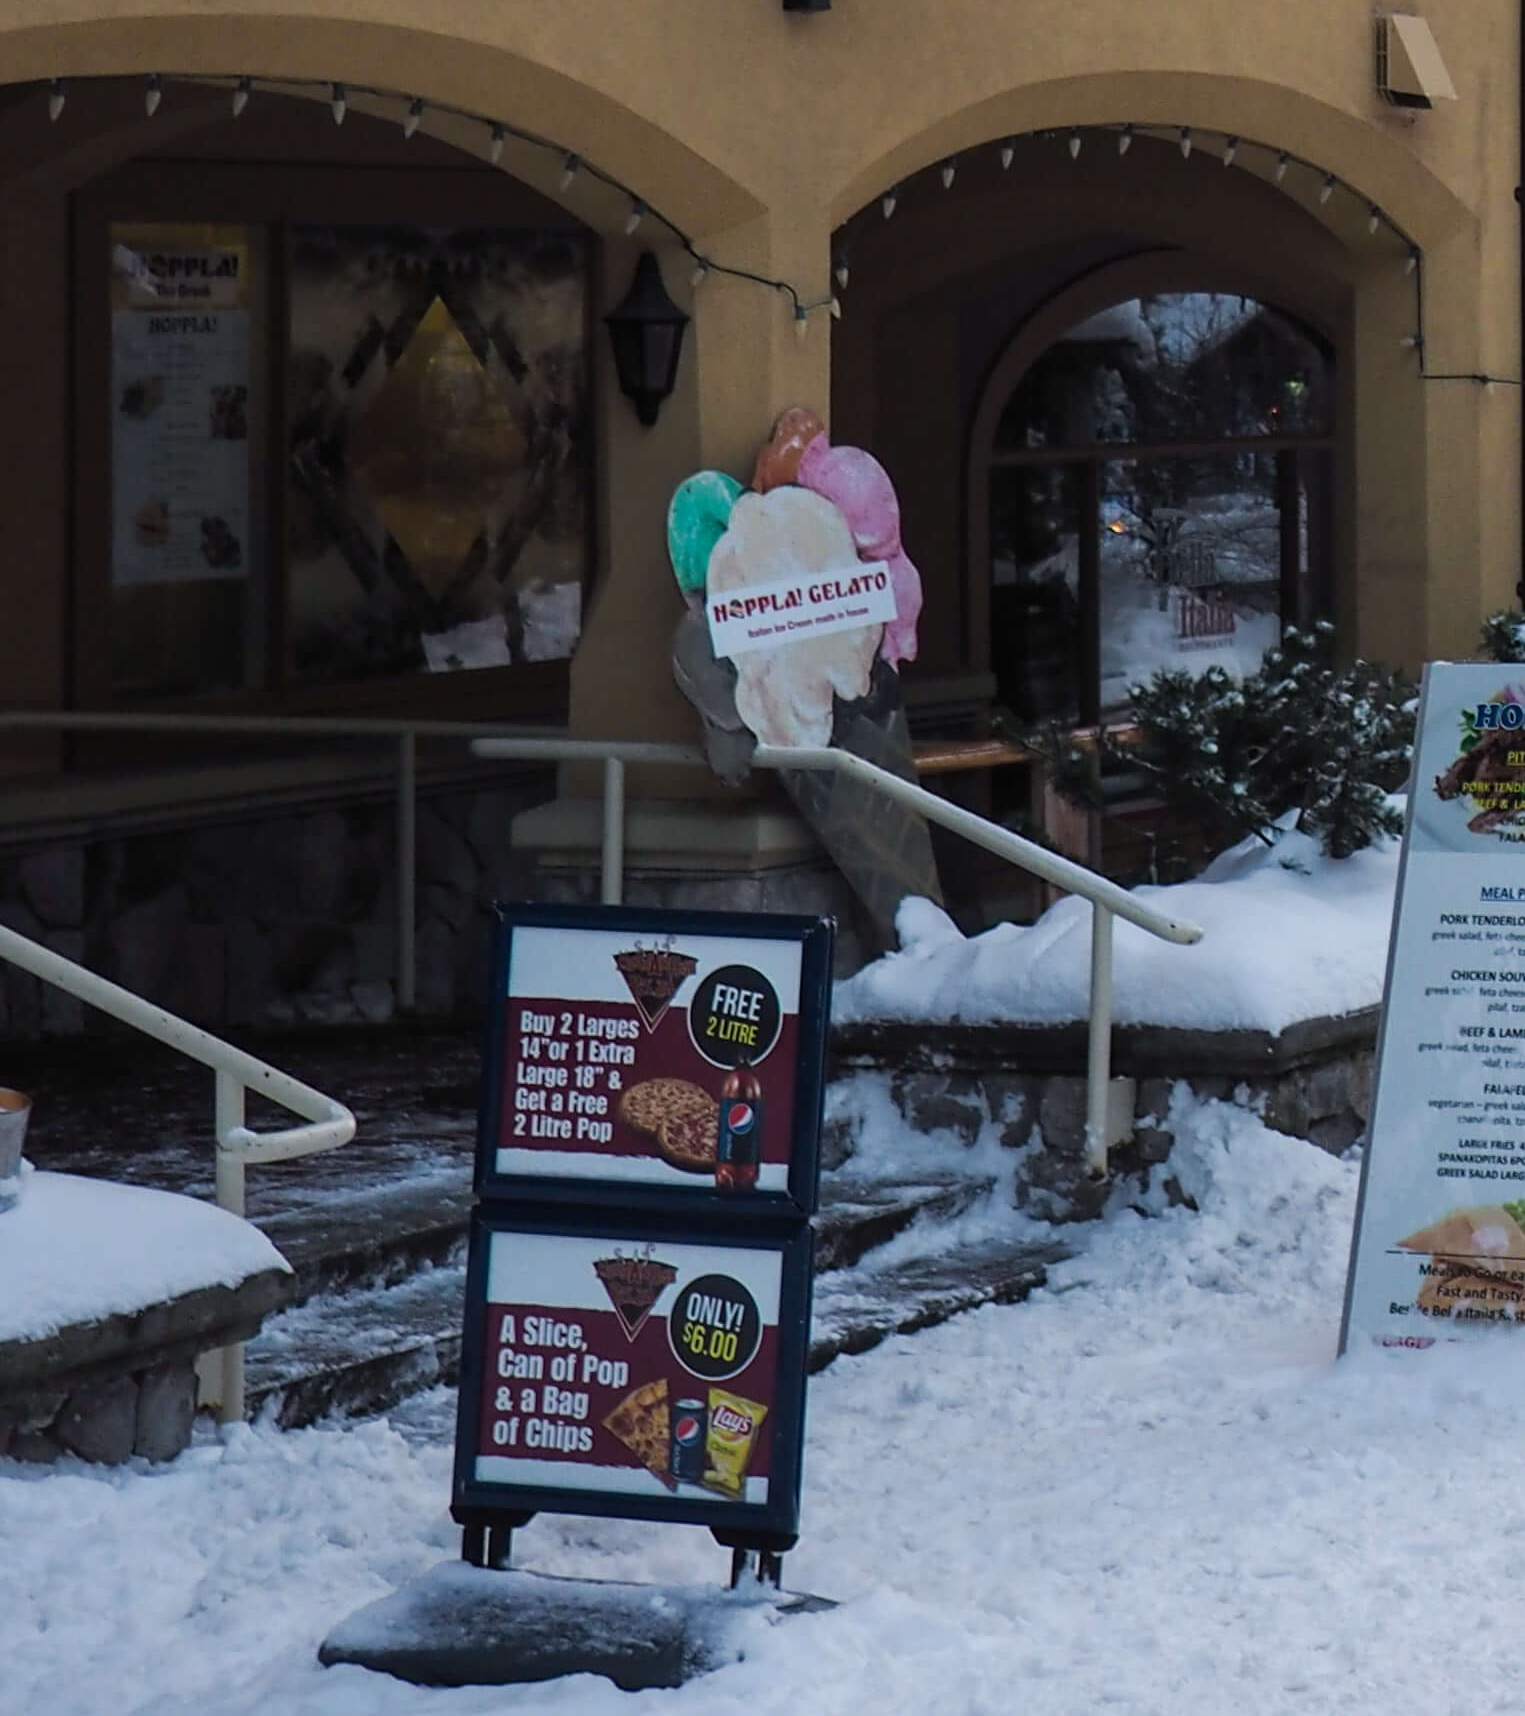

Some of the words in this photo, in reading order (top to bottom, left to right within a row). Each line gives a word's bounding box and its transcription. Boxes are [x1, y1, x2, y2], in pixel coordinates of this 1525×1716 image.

[712, 587, 803, 624] HOPPLA!
[807, 571, 888, 605] GELATO
[1462, 782, 1491, 793] PORK
[1480, 886, 1515, 901] MEAL
[1440, 914, 1469, 925] PORK
[1450, 970, 1497, 982] CHICKEN
[711, 982, 764, 1022] FREE
[520, 1010, 556, 1037] Buy
[560, 1012, 573, 1034] 2
[577, 1013, 640, 1040] Larges
[706, 1016, 717, 1038] 2
[719, 1019, 760, 1047] LITRE
[1459, 1026, 1485, 1037] BEEF
[1487, 1027, 1497, 1038] &
[574, 1039, 584, 1061] 1
[588, 1039, 636, 1066] Extra
[516, 1062, 568, 1088] Large
[574, 1065, 605, 1088] 18"
[608, 1069, 623, 1091] &
[515, 1088, 547, 1112] Get
[551, 1095, 564, 1112] a
[568, 1090, 609, 1115] Free
[513, 1114, 526, 1138] 2
[531, 1115, 574, 1141] Litre
[576, 1117, 613, 1144] Pop
[1438, 1152, 1508, 1165] SPANAKOPITAS
[1490, 1140, 1515, 1151] FRIES
[1436, 1167, 1467, 1179] GREEK
[1468, 1168, 1499, 1180] SALAD
[1436, 1285, 1461, 1298] Fast
[1463, 1286, 1488, 1299] and
[686, 1292, 745, 1333] ONLY!
[499, 1314, 516, 1344] A
[523, 1316, 588, 1352] Slice,
[682, 1322, 738, 1363] $6.00
[497, 1347, 544, 1380] Can
[551, 1353, 577, 1383] of
[582, 1355, 629, 1390] Pop
[495, 1387, 513, 1412] &
[520, 1390, 537, 1413] a
[543, 1386, 589, 1420] Bag
[492, 1419, 520, 1446] of
[525, 1418, 594, 1453] Chips
